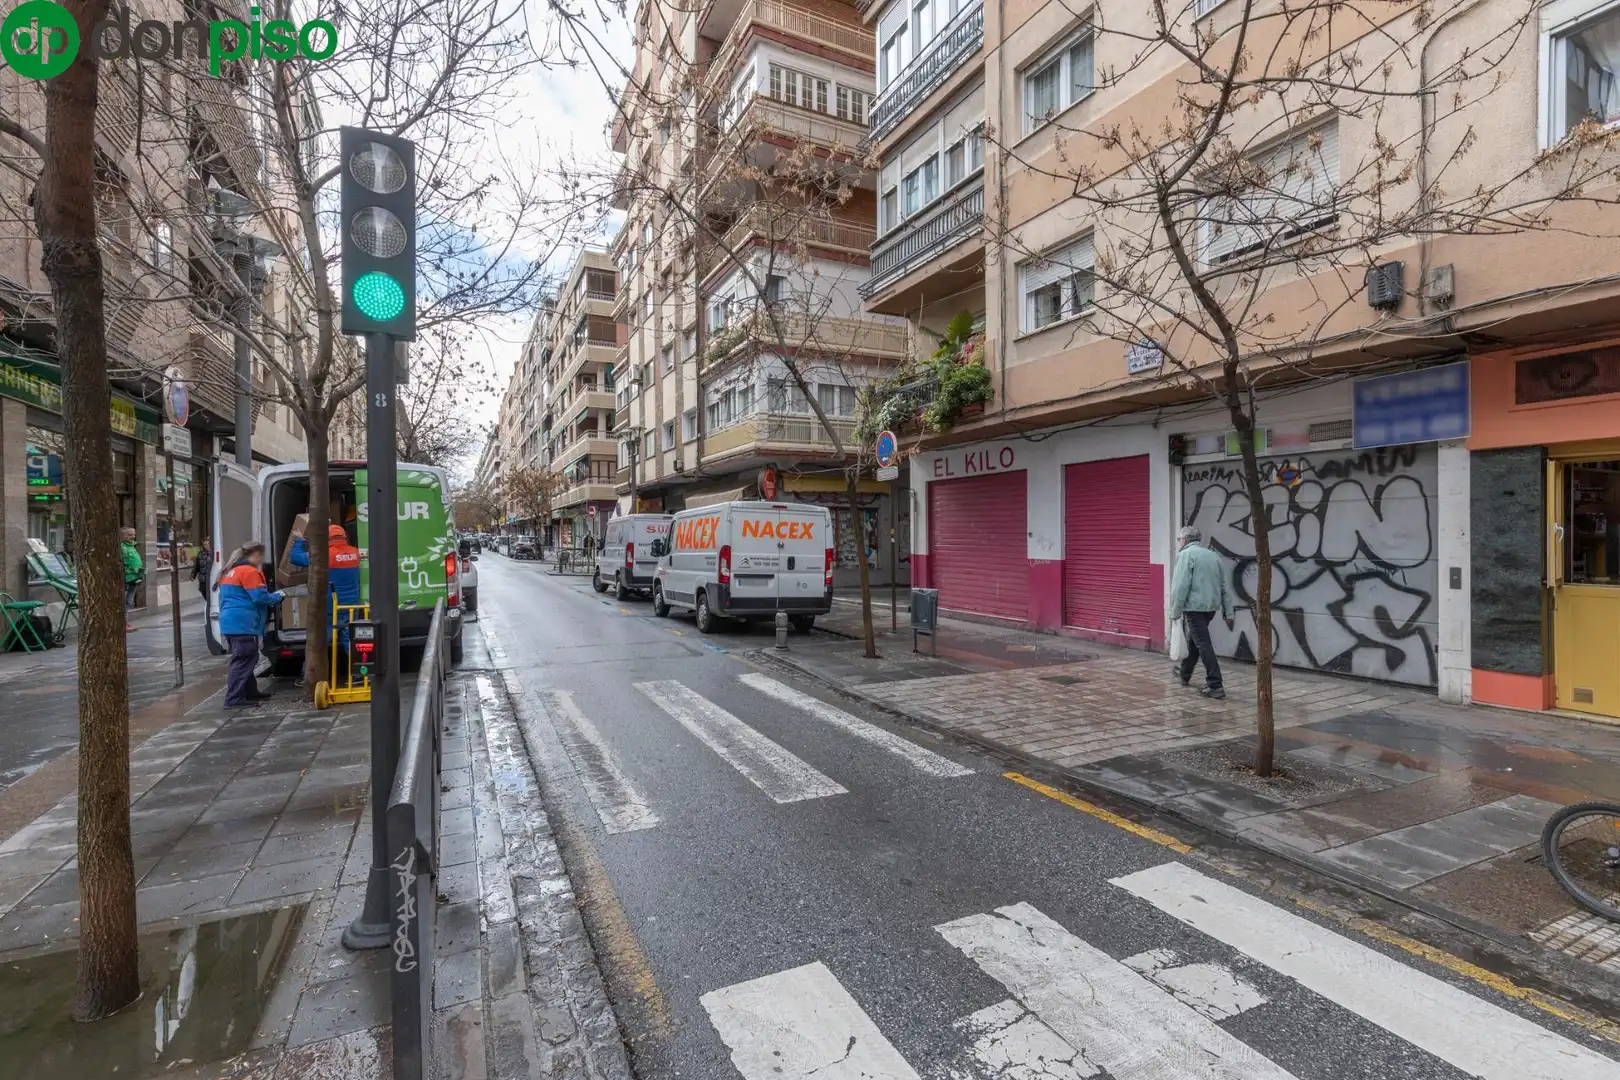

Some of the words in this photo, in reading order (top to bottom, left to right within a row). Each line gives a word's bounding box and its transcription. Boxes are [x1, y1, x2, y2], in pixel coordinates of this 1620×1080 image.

[934, 456, 954, 478] EL
[965, 446, 1014, 474] KILO
[357, 501, 430, 522] SUR
[675, 517, 721, 549] NACEX
[741, 520, 815, 540] NACEX
